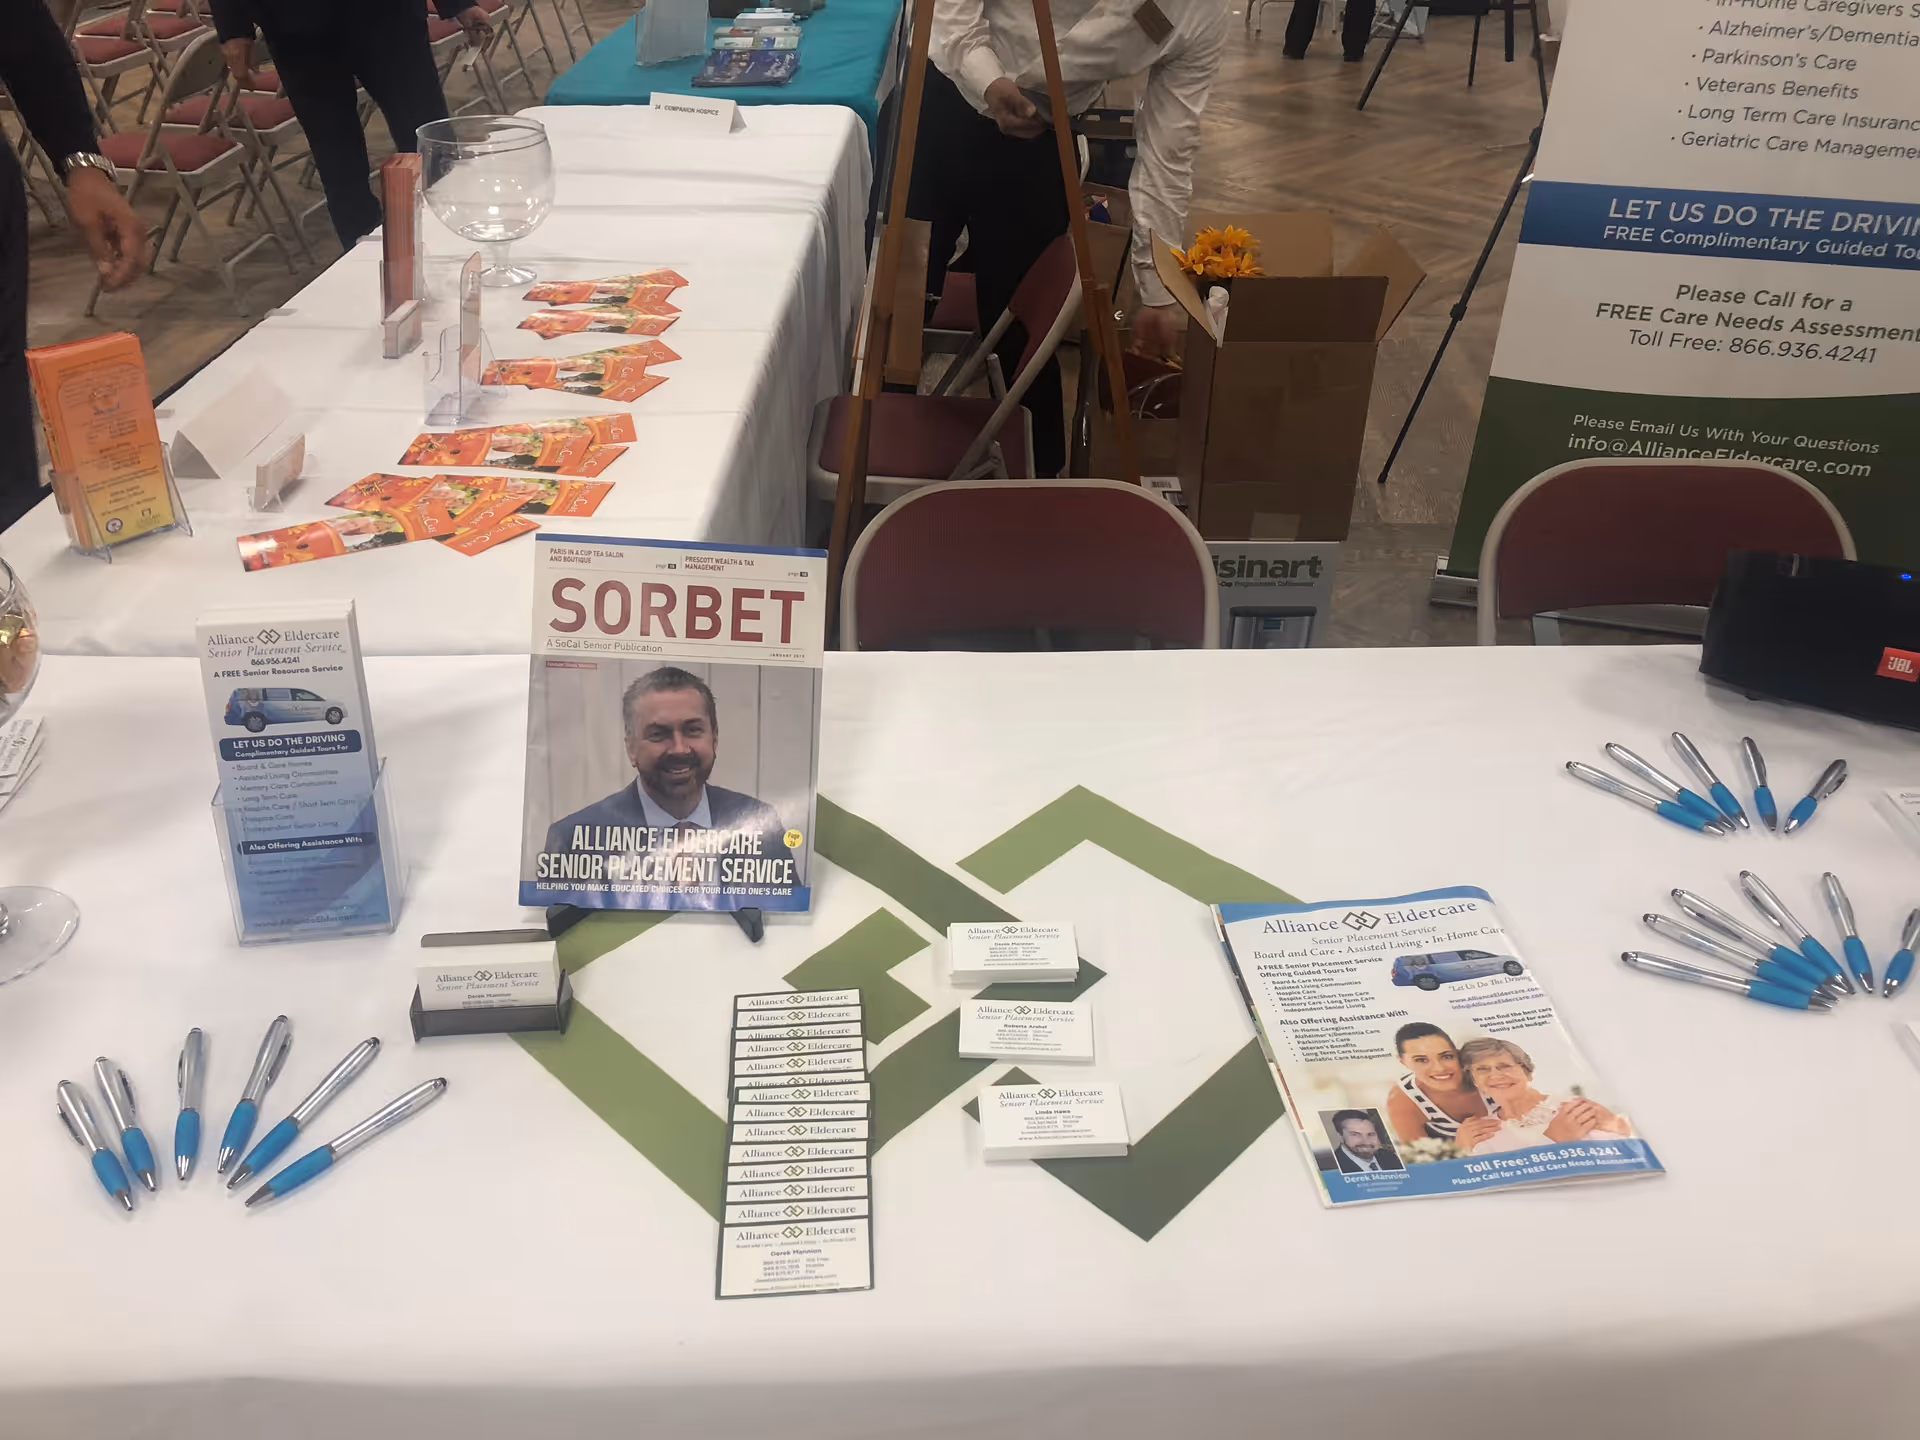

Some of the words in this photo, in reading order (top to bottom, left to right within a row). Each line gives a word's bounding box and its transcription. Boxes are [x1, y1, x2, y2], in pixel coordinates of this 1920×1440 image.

[1803, 0, 1904, 16] Caregivers
[1708, 20, 1920, 46] Alzheimer's/Dementia
[1702, 48, 1808, 68] Parkinson's
[1814, 54, 1858, 70] Care
[1697, 76, 1776, 94] Veterans
[1782, 80, 1859, 100] Benefits
[664, 105, 695, 113] COMPANION
[696, 108, 719, 116] HOSPICE
[1688, 104, 1735, 123] Long
[1742, 107, 1786, 123] Term
[1793, 109, 1836, 126] Care
[1681, 132, 1760, 150] Geriatric
[1766, 136, 1808, 152] Care
[1608, 198, 1662, 220] LET
[1668, 202, 1705, 224] US
[1713, 204, 1758, 226] DO
[1768, 207, 1824, 230] THE
[1604, 226, 1655, 242] FREE
[1660, 228, 1810, 255] Complimentary
[1815, 238, 1887, 257] Guided
[1676, 284, 1746, 304] Please
[1753, 290, 1796, 308] Call
[1801, 292, 1834, 311] for
[1840, 298, 1853, 312] a
[1596, 302, 1653, 322] FREE
[1660, 308, 1708, 326] Care
[1715, 312, 1784, 332] Needs
[1790, 318, 1920, 342] Assessment
[1628, 329, 1664, 346] Toll
[1668, 332, 1722, 351] Free:
[1729, 338, 1877, 363] 866.936.4241
[1573, 414, 1625, 430] Please
[1630, 420, 1674, 436] Email
[1679, 424, 1700, 438] Us
[1706, 427, 1744, 442] With
[1751, 430, 1789, 446] Your
[1794, 436, 1880, 454] Questions
[550, 548, 567, 556] PARIS
[580, 550, 592, 558] CUP
[563, 556, 592, 564] BOUTIQUE
[685, 556, 714, 565] PRESCOTT
[715, 558, 738, 566] WEALTH
[744, 559, 754, 567] TAX
[685, 563, 724, 572] MANAGEMENT
[549, 577, 805, 644] SORBET
[208, 634, 254, 646] Alliance
[284, 630, 340, 642] Eldercare
[546, 638, 553, 648] A
[556, 640, 580, 649] SoCal
[584, 641, 611, 651] Senior
[614, 642, 662, 652] Publication
[208, 648, 242, 658] Senior
[246, 644, 300, 657] Placement
[304, 643, 342, 654] Service
[222, 670, 241, 678] FREE
[243, 668, 269, 677] Senior
[272, 667, 310, 675] Resource
[312, 665, 343, 673] Service
[1888, 656, 1913, 674] JBL
[233, 740, 250, 749] LET
[251, 740, 265, 748] US
[268, 738, 282, 747] DO
[285, 737, 303, 745] THE
[305, 734, 346, 744] DRIVING
[235, 749, 288, 758] Complimentary
[290, 747, 315, 755] Guided
[572, 825, 658, 852] ALLIANCE
[663, 828, 763, 855] ELDERCARE
[788, 832, 800, 840] Page
[268, 842, 300, 850] Offering
[302, 838, 344, 847] Assistance
[536, 853, 602, 880] SENIOR
[607, 854, 716, 882] PLACEMENT
[721, 858, 794, 884] SERVICE
[536, 882, 569, 891] HELPING
[571, 883, 586, 891] YOU
[587, 884, 609, 892] MAKE
[610, 884, 649, 893] EDUCATED
[685, 886, 700, 894] FOR
[701, 886, 721, 894] YOUR
[723, 886, 746, 895] LOVED
[748, 886, 771, 895] ONE'S
[773, 887, 792, 896] CARE
[1263, 918, 1339, 934] Alliance
[1384, 902, 1478, 925] Eldercare
[1311, 936, 1344, 945] Senior
[1346, 930, 1398, 943] Placement
[1401, 925, 1437, 937] Service
[1253, 950, 1285, 960] Board
[1288, 948, 1308, 958] and
[1310, 947, 1335, 957] Care
[1346, 941, 1386, 954] Assisted
[1389, 938, 1423, 950] Living
[1431, 929, 1478, 944] In-Home
[1480, 926, 1505, 935] Care
[1285, 962, 1309, 970] Senior
[1311, 959, 1353, 968] Placement
[435, 974, 473, 983] Alliance
[494, 971, 538, 979] Eldercare
[1260, 971, 1292, 979] Offering
[466, 982, 508, 990] Placement
[511, 980, 540, 988] Service
[748, 999, 785, 1007] Alliance
[806, 994, 849, 1002] Eldercare
[977, 1006, 1013, 1014] Alliance
[1300, 1016, 1338, 1025] Offering
[1339, 1013, 1385, 1022] Assistance
[1387, 1009, 1408, 1018] With
[750, 1093, 790, 1101] Alliance
[813, 1089, 860, 1097] Eldercare
[998, 1092, 1037, 1100] Alliance
[1058, 1090, 1103, 1098] Eldercare
[1464, 1161, 1491, 1175] Toll
[1493, 1156, 1529, 1170] Free:
[1530, 1146, 1622, 1164] 866.936.4241
[1344, 1174, 1370, 1184] Derek
[1371, 1171, 1410, 1181] Mannion
[736, 1232, 780, 1241] Alliance
[806, 1227, 856, 1236] Eldercare
